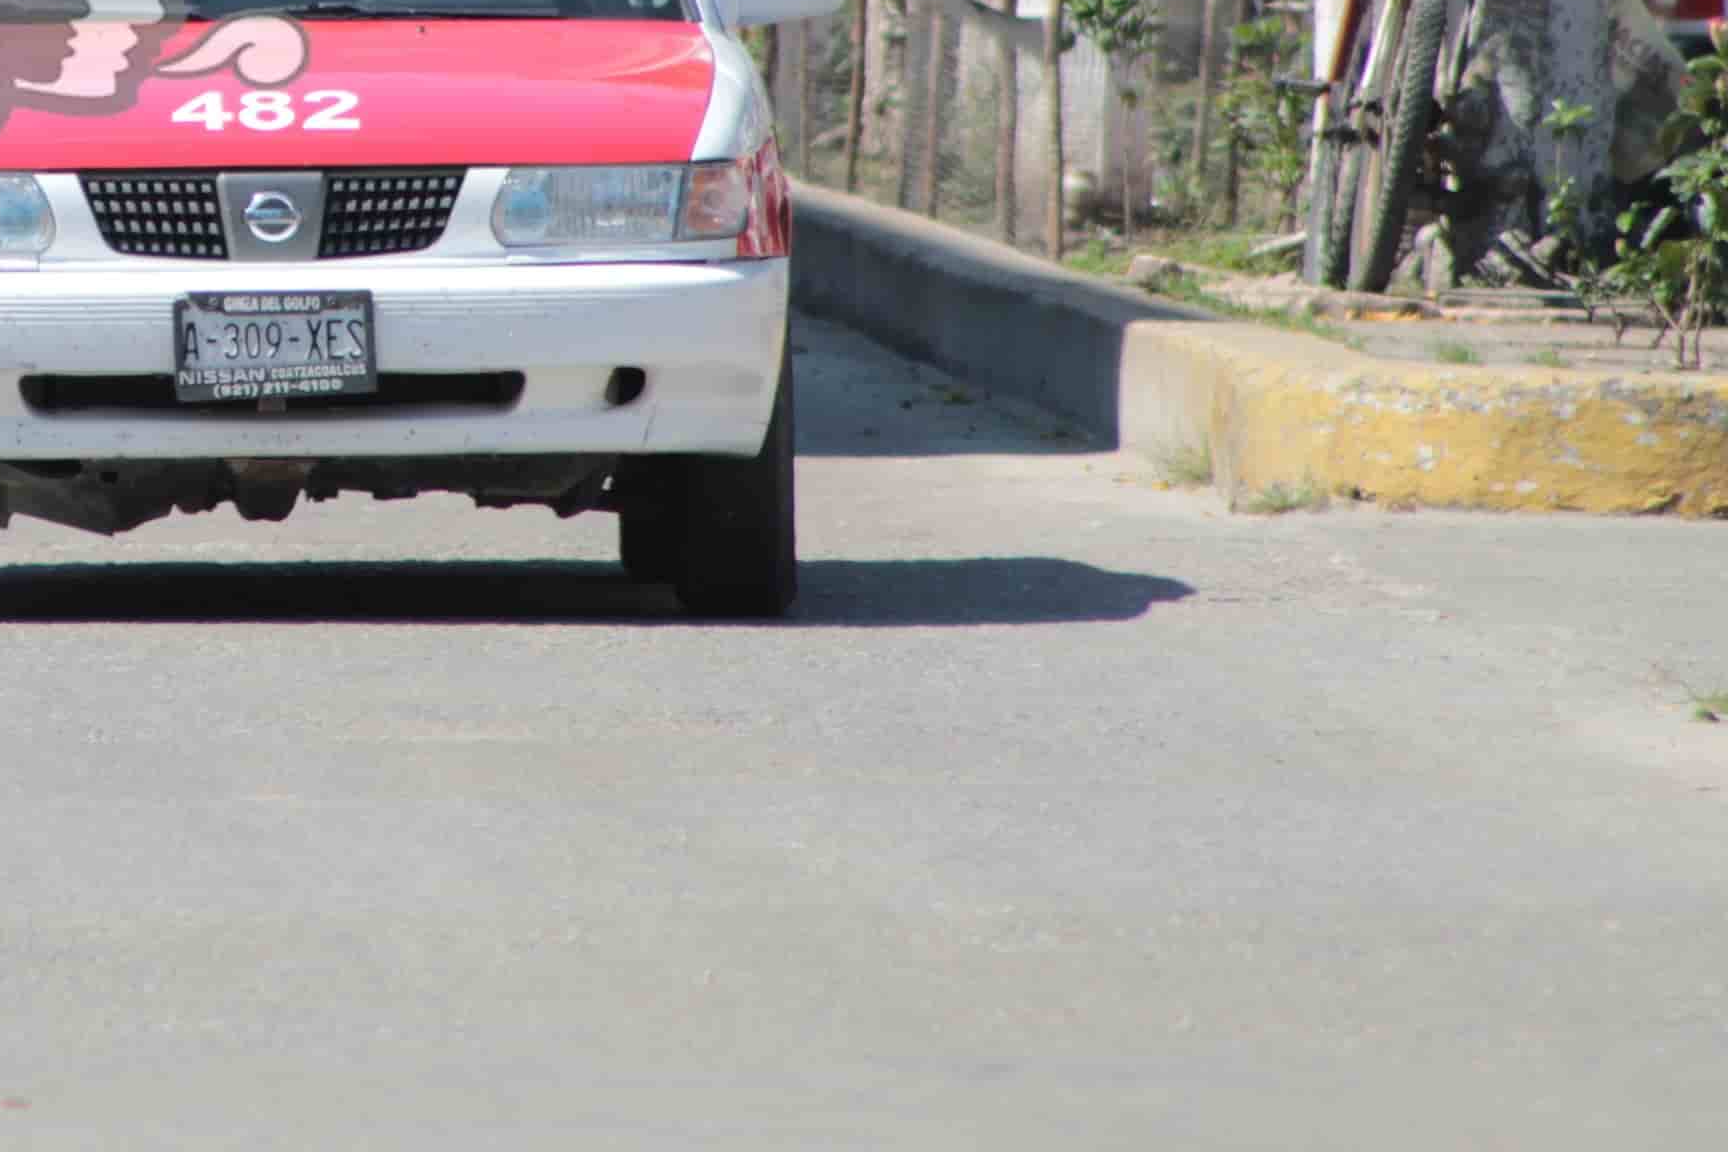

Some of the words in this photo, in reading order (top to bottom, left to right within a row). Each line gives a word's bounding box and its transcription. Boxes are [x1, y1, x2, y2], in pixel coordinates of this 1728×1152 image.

[171, 89, 361, 131] 482
[183, 319, 365, 361] A-309-XES
[178, 366, 266, 385] NISSAN
